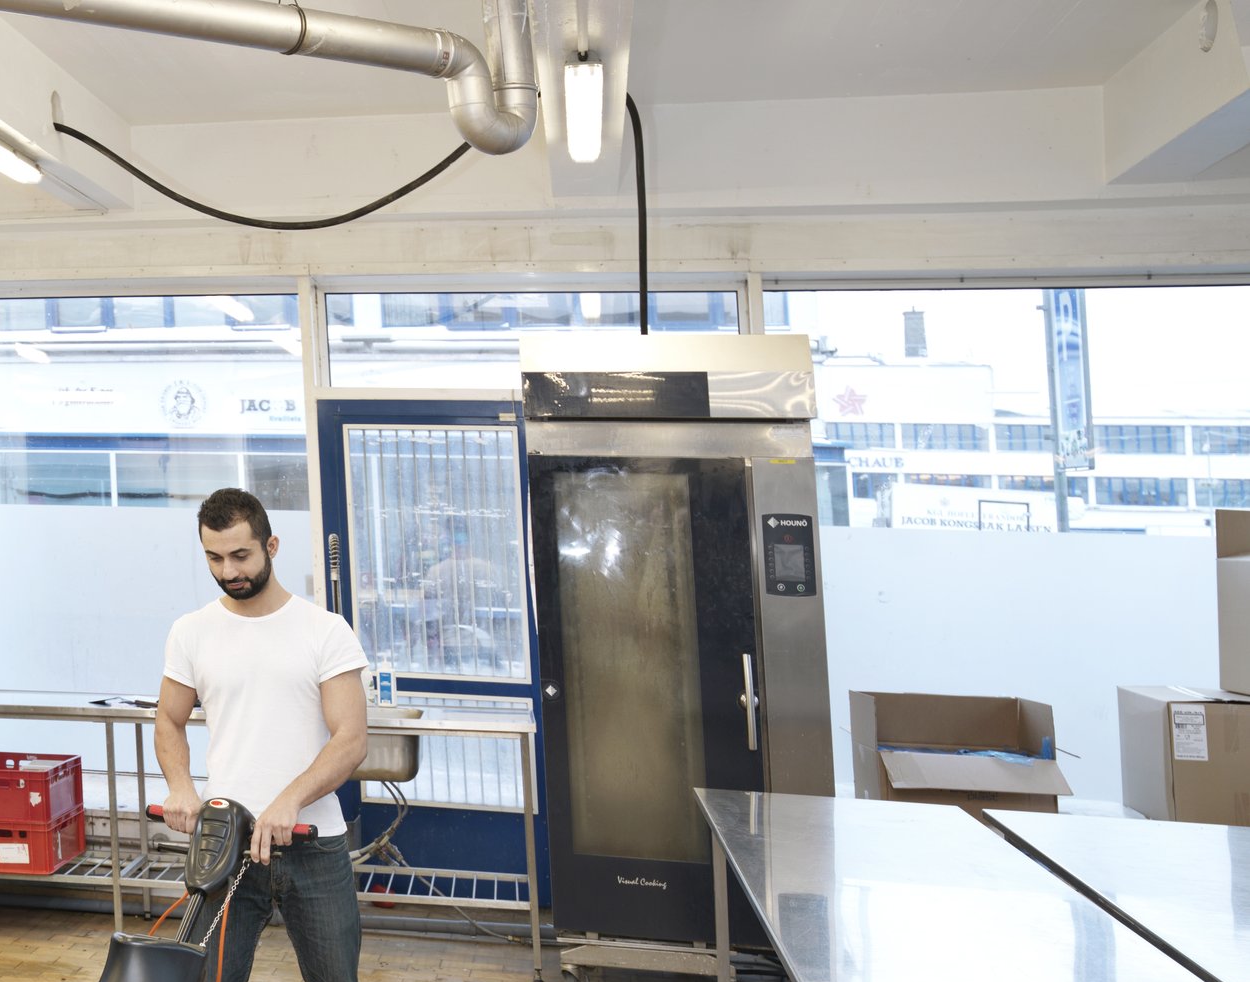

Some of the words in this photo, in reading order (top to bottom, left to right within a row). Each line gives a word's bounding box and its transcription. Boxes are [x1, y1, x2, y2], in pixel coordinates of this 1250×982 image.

[239, 399, 296, 414] JACB
[901, 516, 937, 526] JACOB
[617, 875, 639, 885] Visual
[640, 877, 667, 890] Cooking
